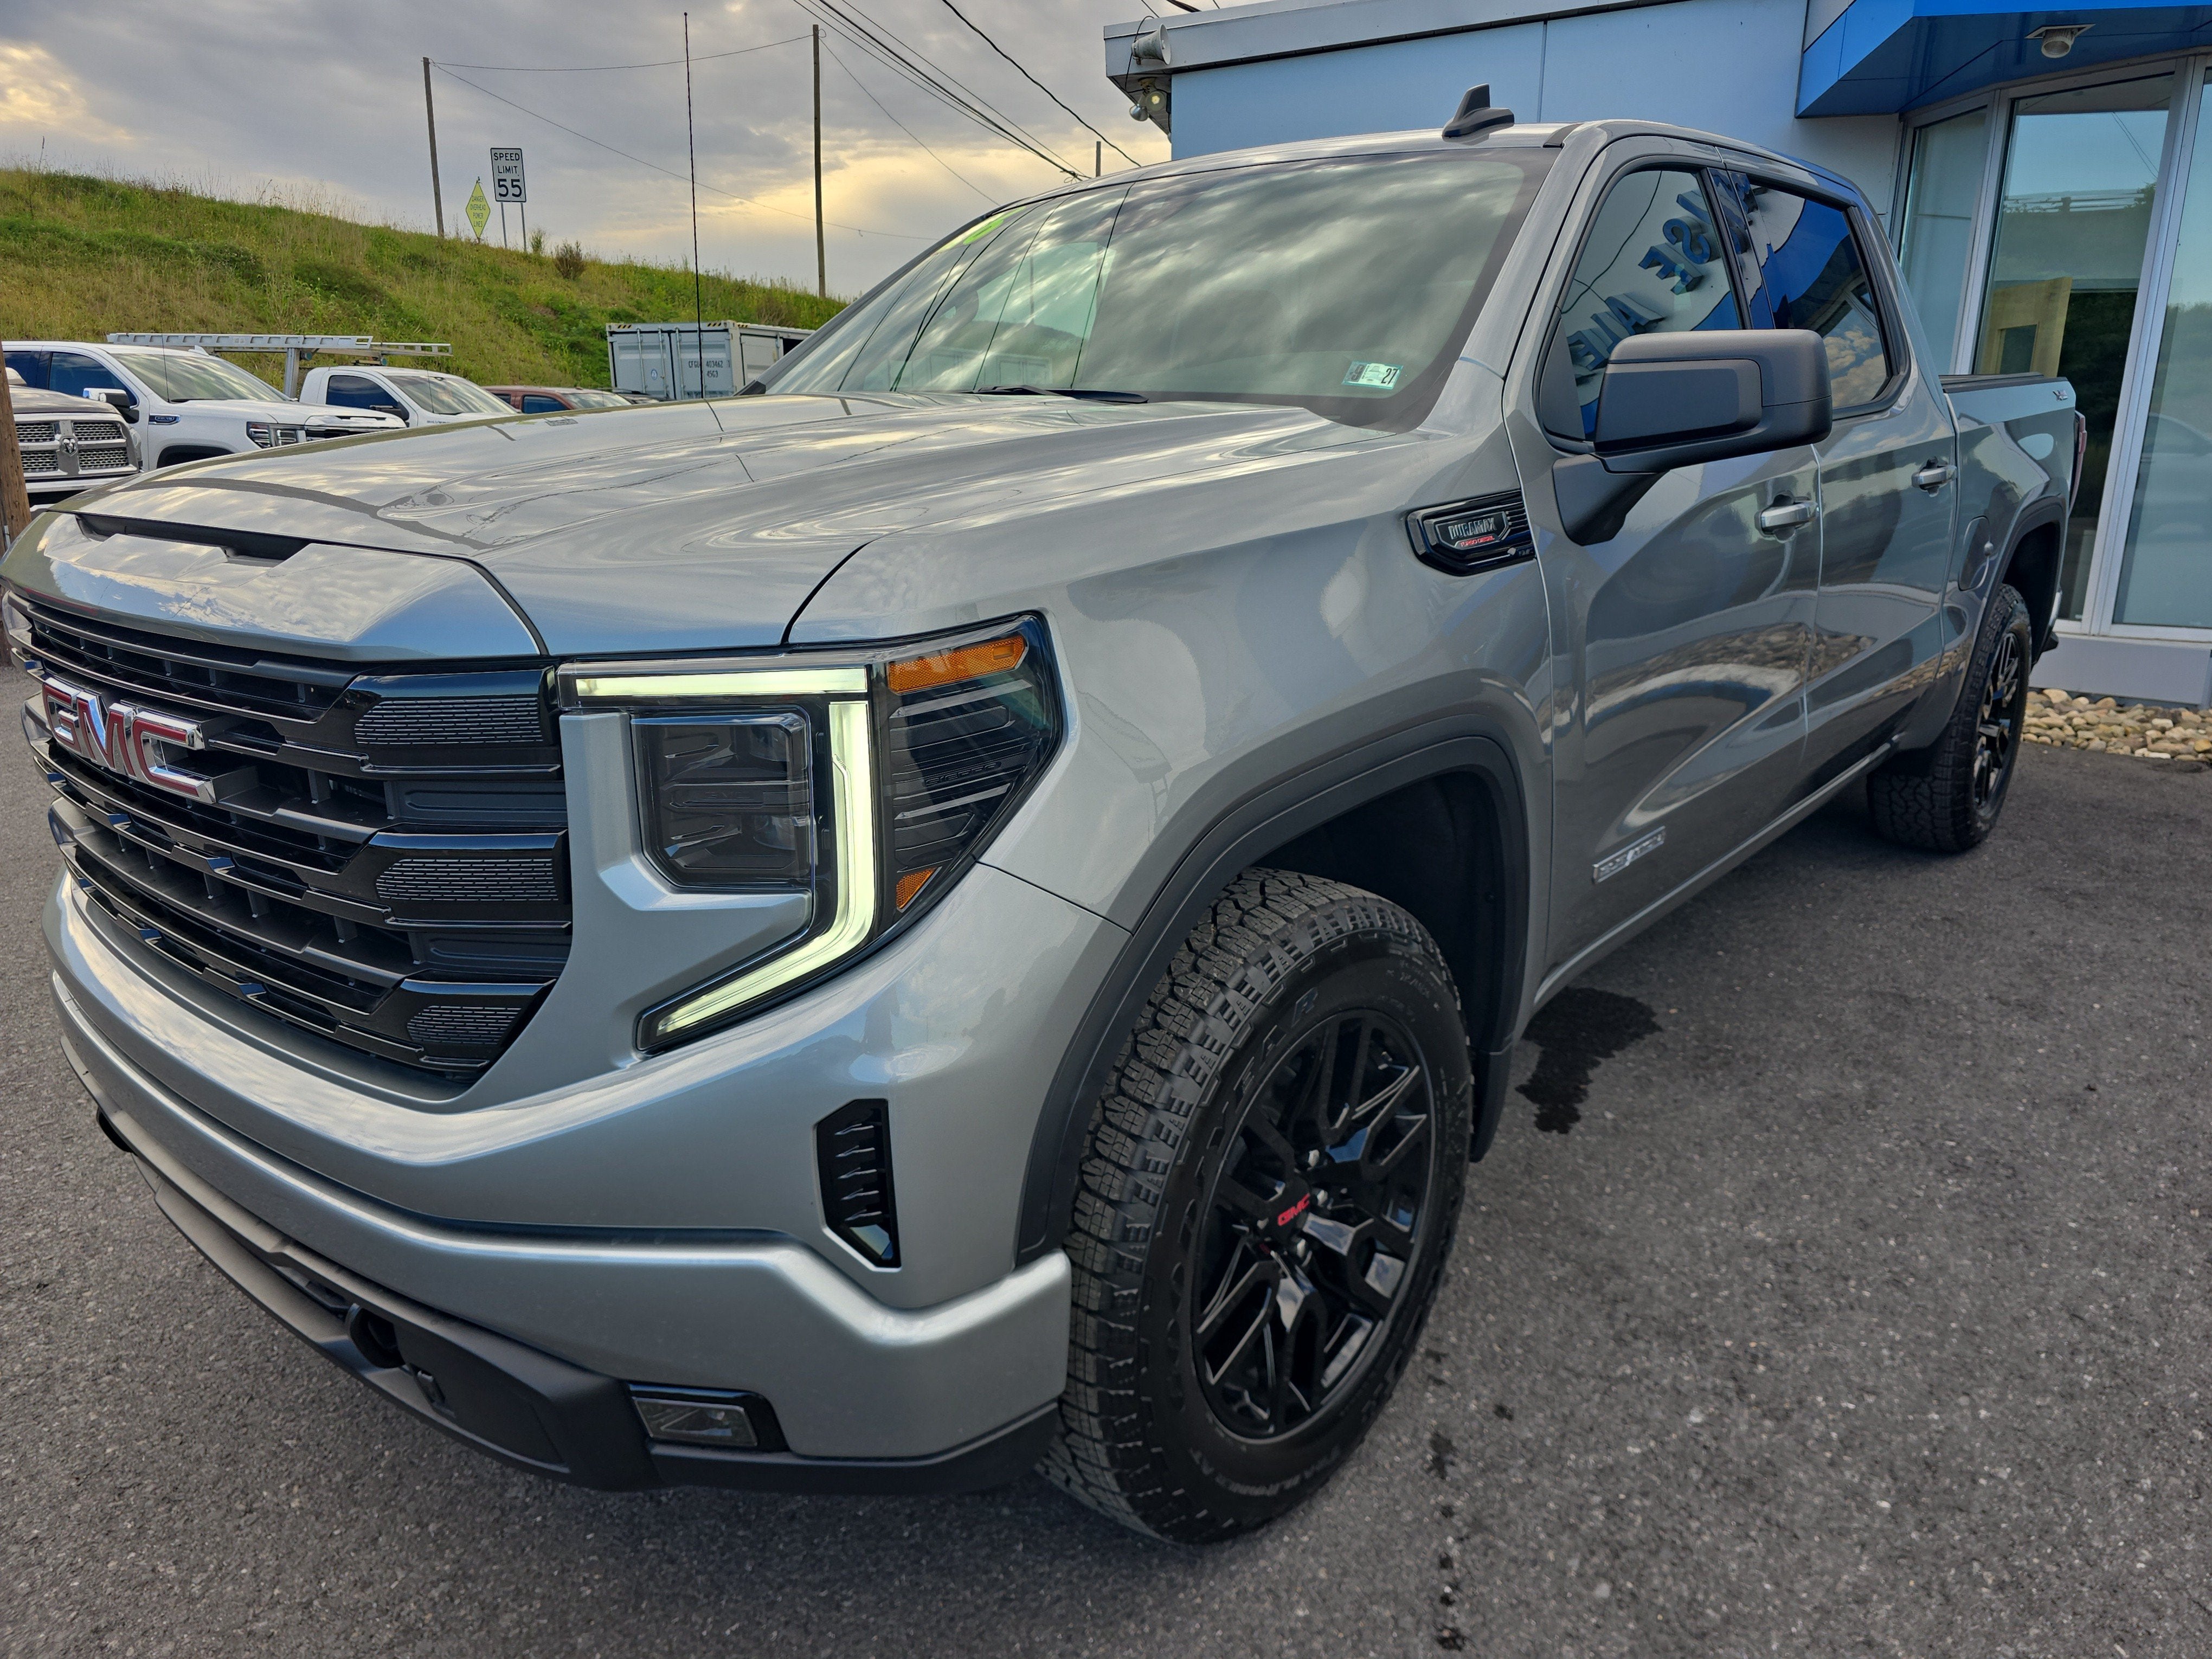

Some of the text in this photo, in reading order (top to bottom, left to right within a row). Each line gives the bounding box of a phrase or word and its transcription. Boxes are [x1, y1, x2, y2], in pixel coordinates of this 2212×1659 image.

[494, 152, 520, 161] SPEED
[498, 165, 518, 173] LIMIT
[497, 178, 522, 197] 55
[706, 360, 723, 368] 403462
[1381, 368, 1399, 385] 27
[1448, 517, 1496, 540] DURAMAX
[42, 677, 216, 803] GMC
[1277, 1193, 1310, 1226] GMC
